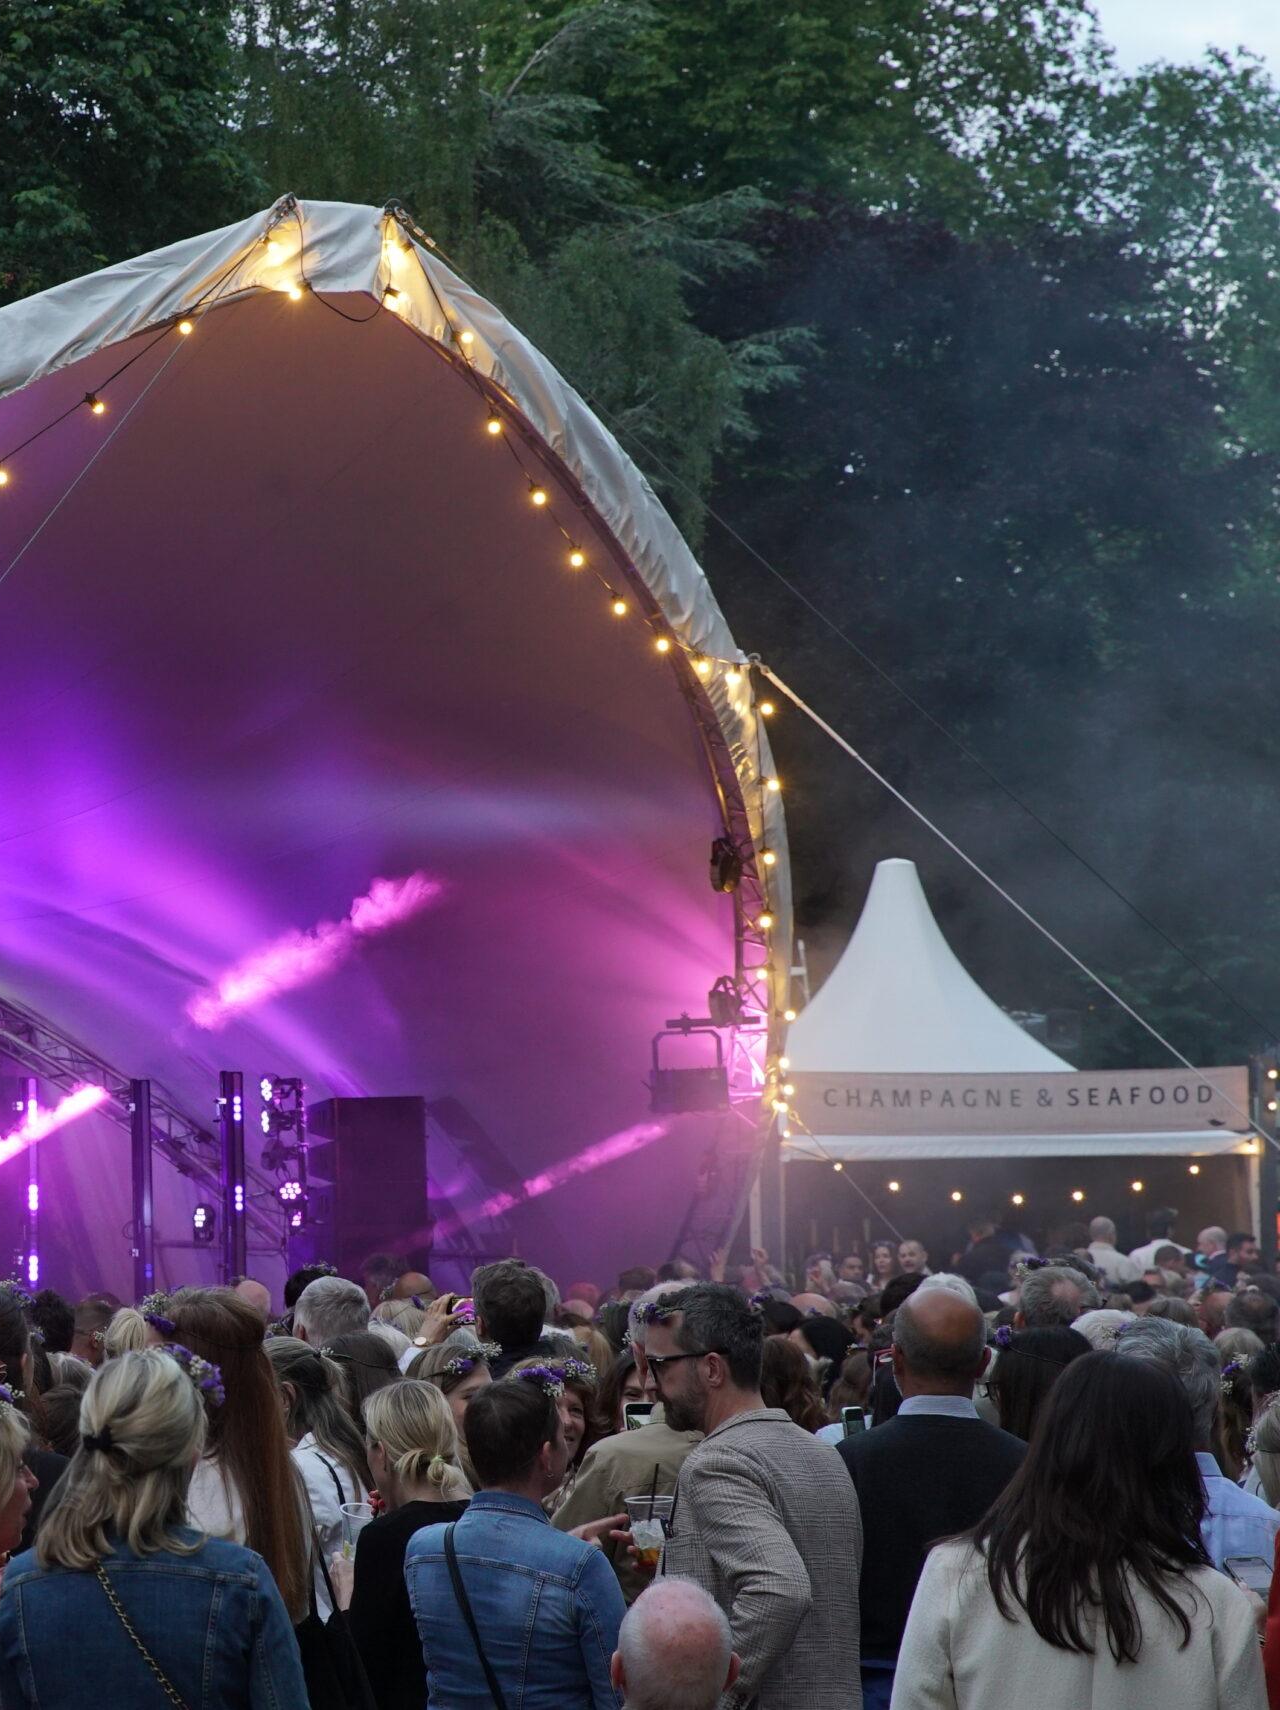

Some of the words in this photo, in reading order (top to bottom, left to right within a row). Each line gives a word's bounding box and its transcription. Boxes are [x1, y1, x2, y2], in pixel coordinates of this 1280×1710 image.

[823, 1087, 1023, 1108] CHAMPAGNE
[1036, 1087, 1053, 1108] &
[1066, 1084, 1213, 1107] SEAFOOD
